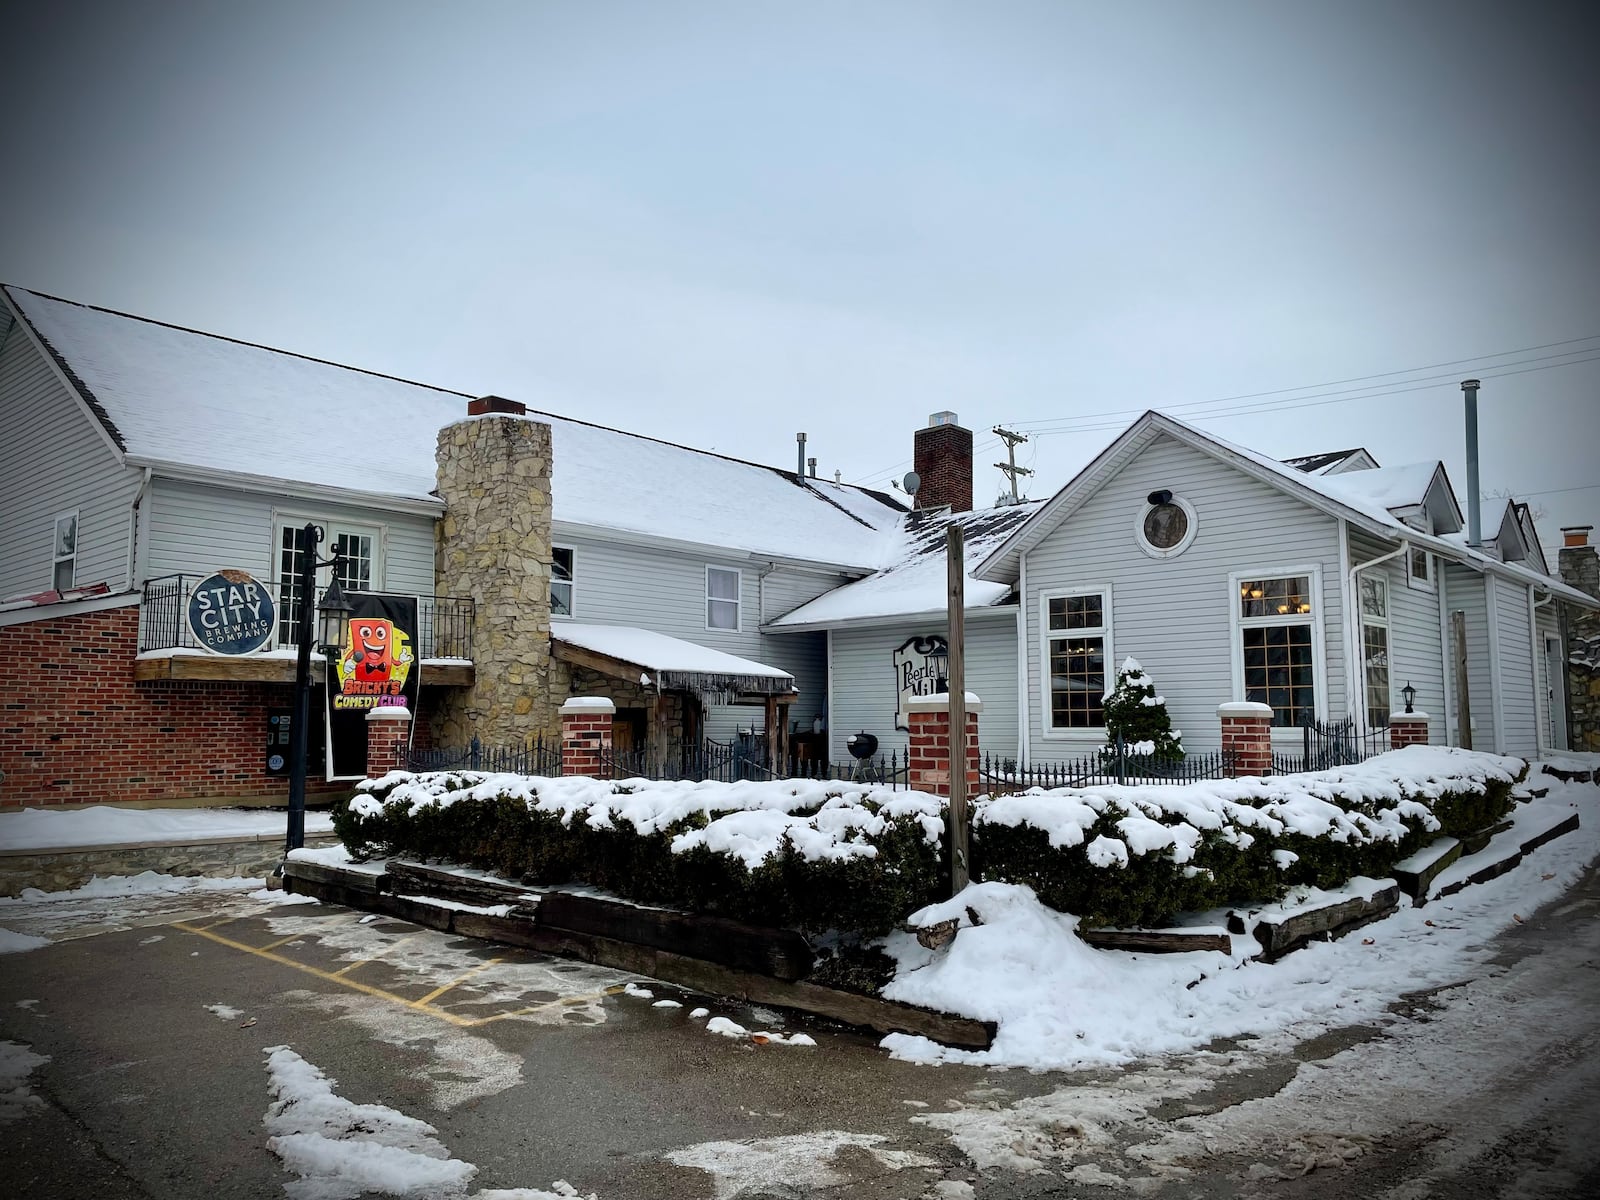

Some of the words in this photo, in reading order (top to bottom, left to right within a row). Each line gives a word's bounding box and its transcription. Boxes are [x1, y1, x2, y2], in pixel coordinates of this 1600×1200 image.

[196, 583, 260, 610] STAR
[200, 601, 261, 629] CITY
[205, 619, 268, 638] BREWING
[207, 626, 269, 645] COMPANY
[901, 655, 937, 692] Peerle
[911, 678, 936, 696] Mil
[334, 694, 380, 709] COMEDY
[379, 694, 407, 707] CLUB
